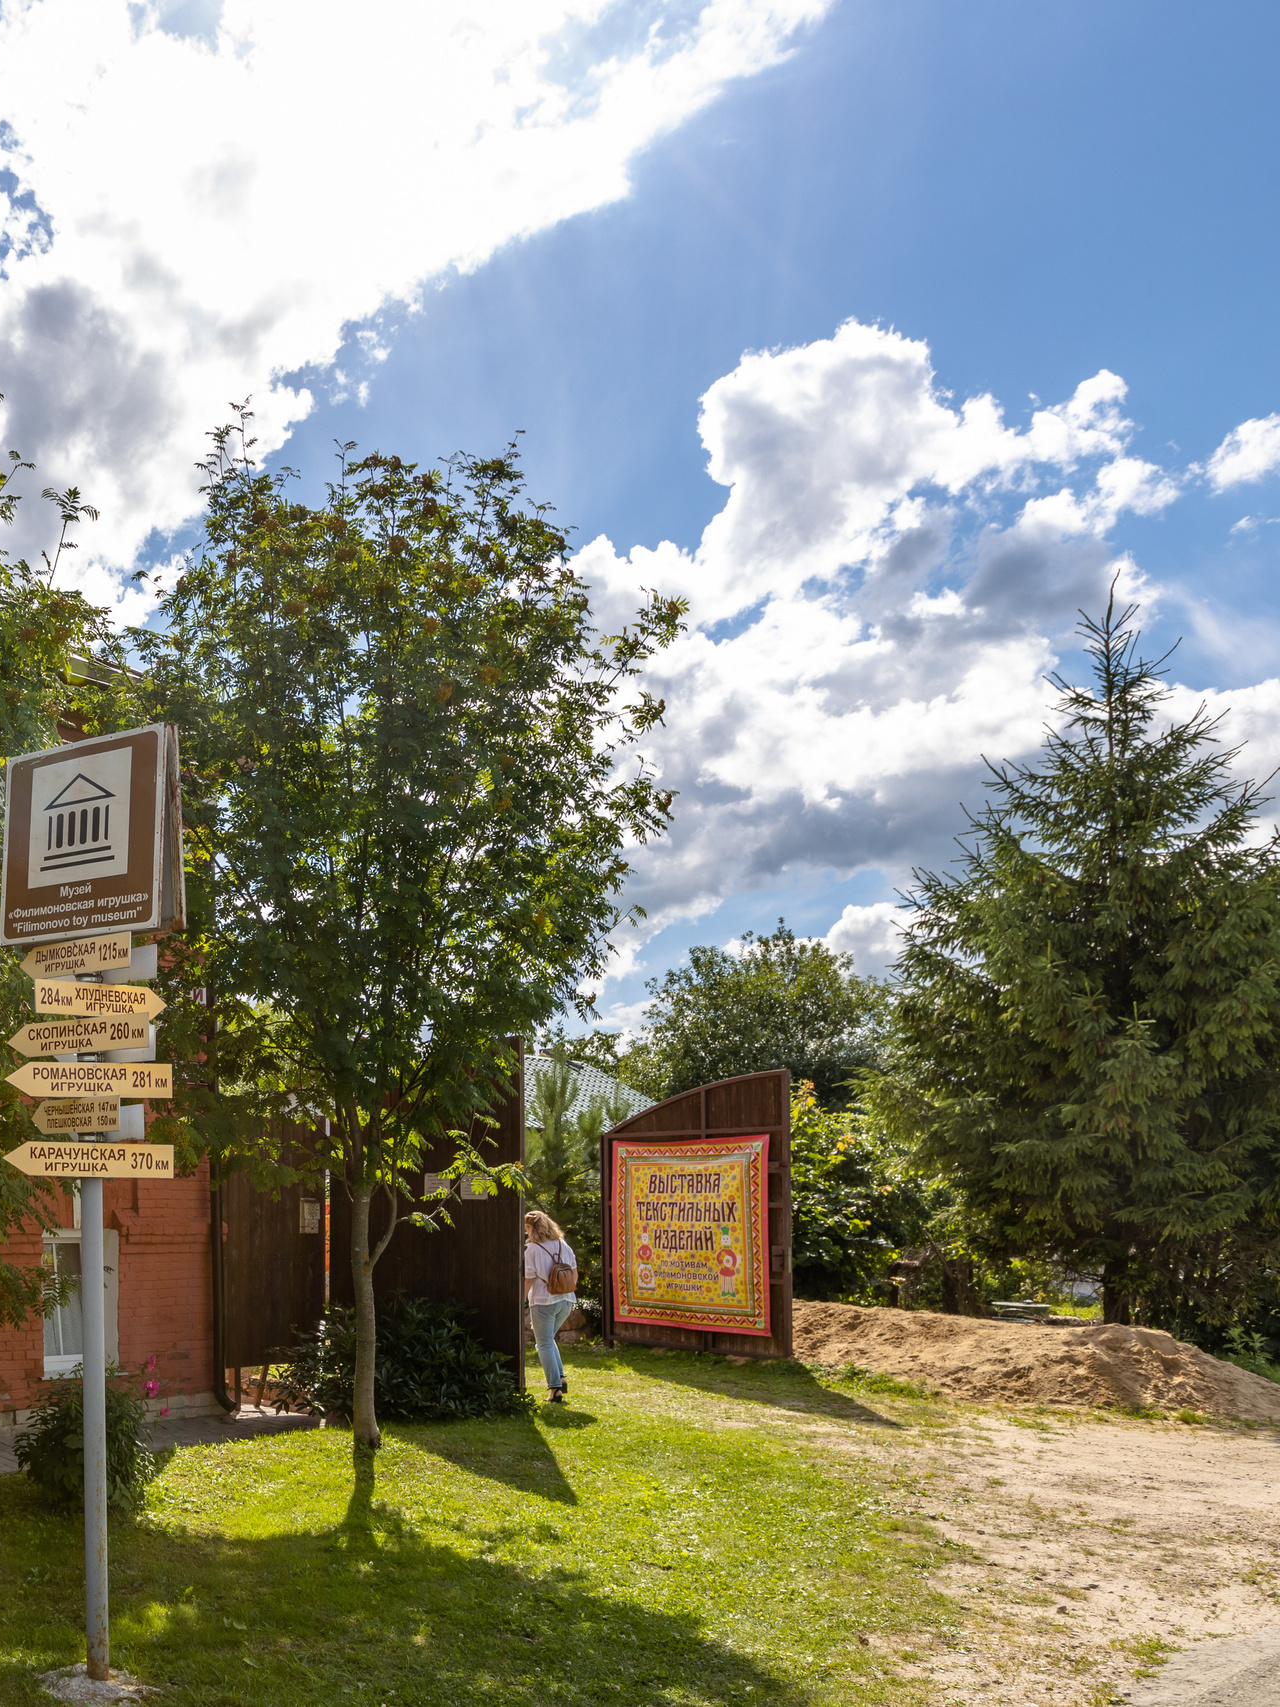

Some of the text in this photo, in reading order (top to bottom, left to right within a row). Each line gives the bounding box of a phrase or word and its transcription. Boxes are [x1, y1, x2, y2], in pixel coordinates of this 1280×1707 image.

[60, 883, 92, 899] Музей
[8, 891, 148, 920] «Филимоновская игрушка»
[12, 907, 142, 933] "Filimonovo toy museum"
[35, 942, 96, 965] ДЫМКОВСКАЯ
[44, 959, 86, 973] ИГРУШКА
[75, 987, 146, 1005] ХЛУДНЕВСКАЯ
[86, 1002, 135, 1014] ИГРУШКА
[28, 1022, 107, 1041] СКОПИНСКАЯ
[110, 1022, 130, 1041] 260
[40, 1038, 93, 1051] ИГРУШКА
[32, 1067, 127, 1081] РОМАНОВСКАЯ
[132, 1071, 152, 1088] 281
[51, 1082, 113, 1092] ИГРУШКА
[44, 1102, 95, 1115] ЧЕРНЫШЕНСКАЯ
[47, 1116, 92, 1129] ПЛЕШКОВСКАЯ
[30, 1147, 126, 1161] КАРАЧУНСКАЯ
[131, 1152, 153, 1170] 370
[45, 1162, 108, 1172] ИГРУШКА
[649, 1173, 721, 1194] ВЫСТАВКА
[636, 1202, 736, 1222] ТЕКСТИЛЬНЫХ
[654, 1226, 714, 1252] ИЗДЕЛИЙ
[670, 1261, 708, 1269] МОТИВАМ
[654, 1271, 719, 1280] ФИЛИМОНОВСКОЙ
[666, 1283, 702, 1291] ИГРУШКИ
